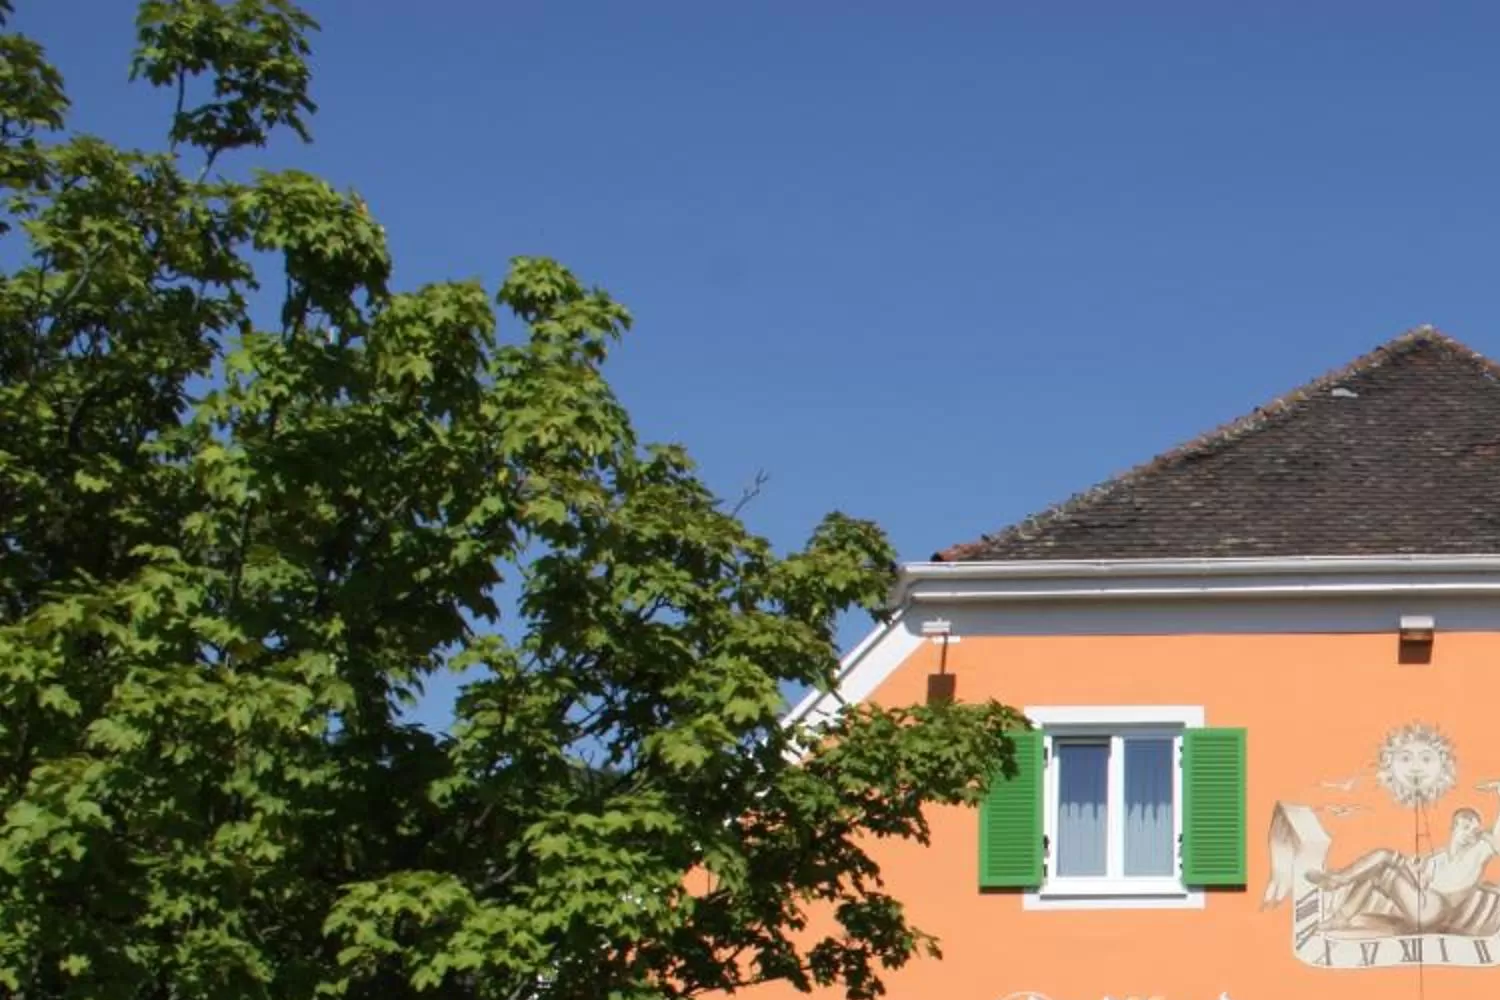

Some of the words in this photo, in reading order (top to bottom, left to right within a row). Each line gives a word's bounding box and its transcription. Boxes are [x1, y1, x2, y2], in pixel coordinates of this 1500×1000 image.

[1399, 937, 1423, 963] XII
[1438, 936, 1449, 962] I
[1474, 938, 1492, 963] II
